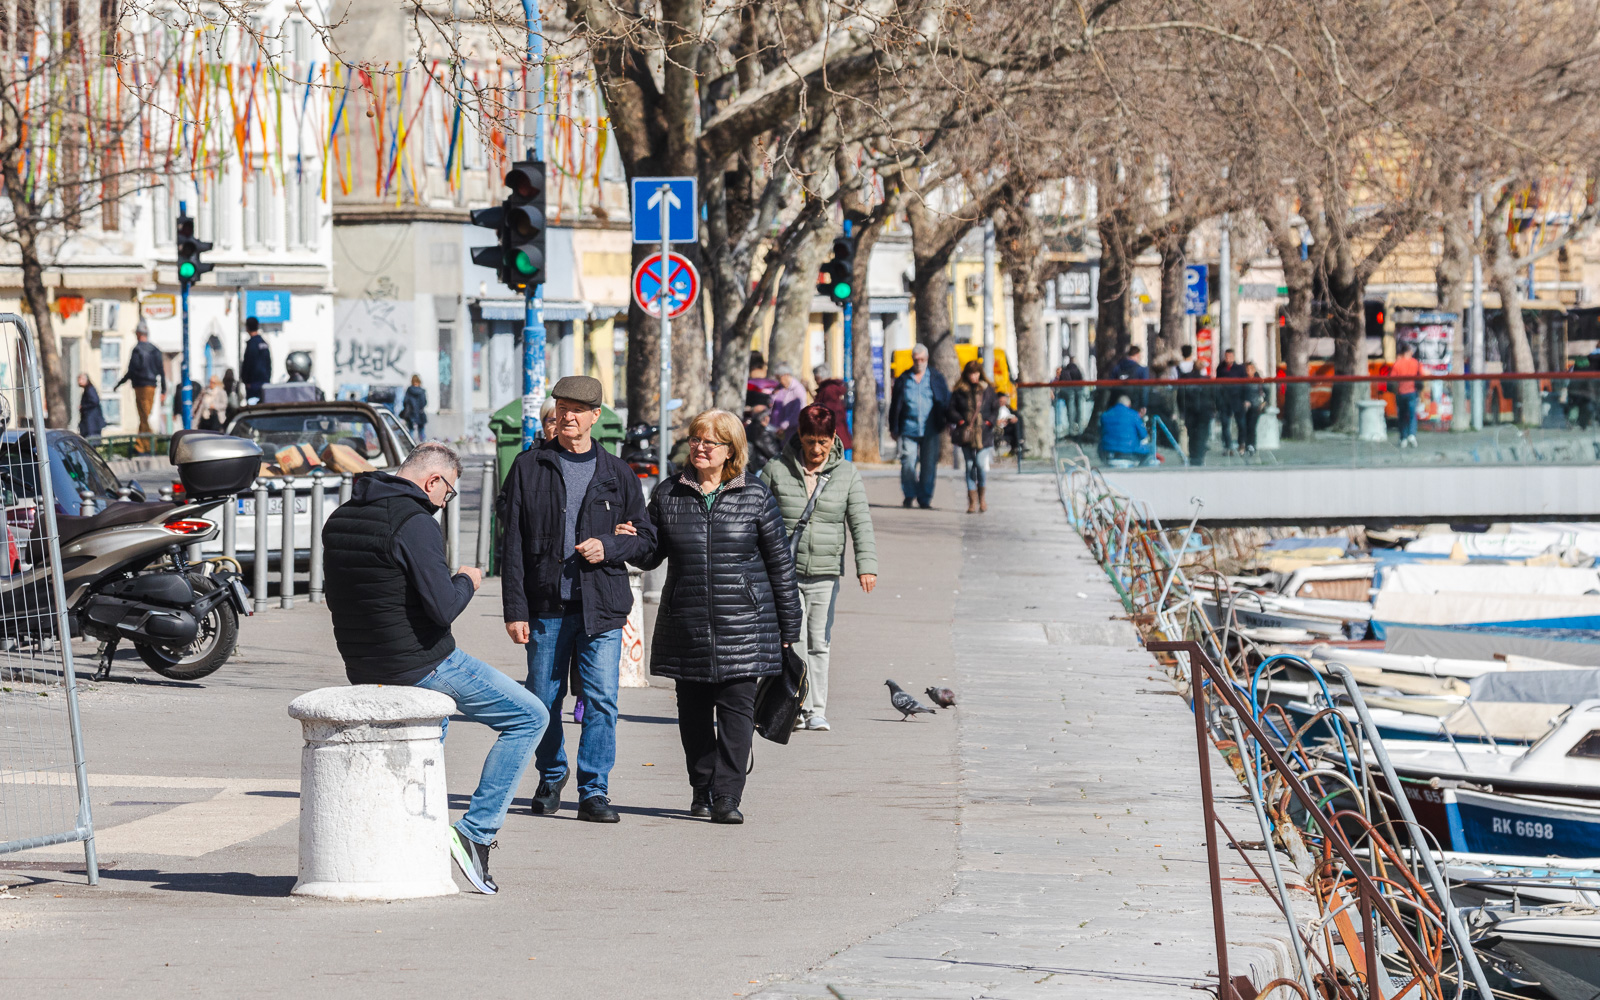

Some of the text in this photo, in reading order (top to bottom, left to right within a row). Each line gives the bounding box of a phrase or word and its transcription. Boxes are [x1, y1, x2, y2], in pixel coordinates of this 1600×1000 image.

[1404, 786, 1444, 804] RK 65
[1493, 817, 1554, 840] RK 6698
